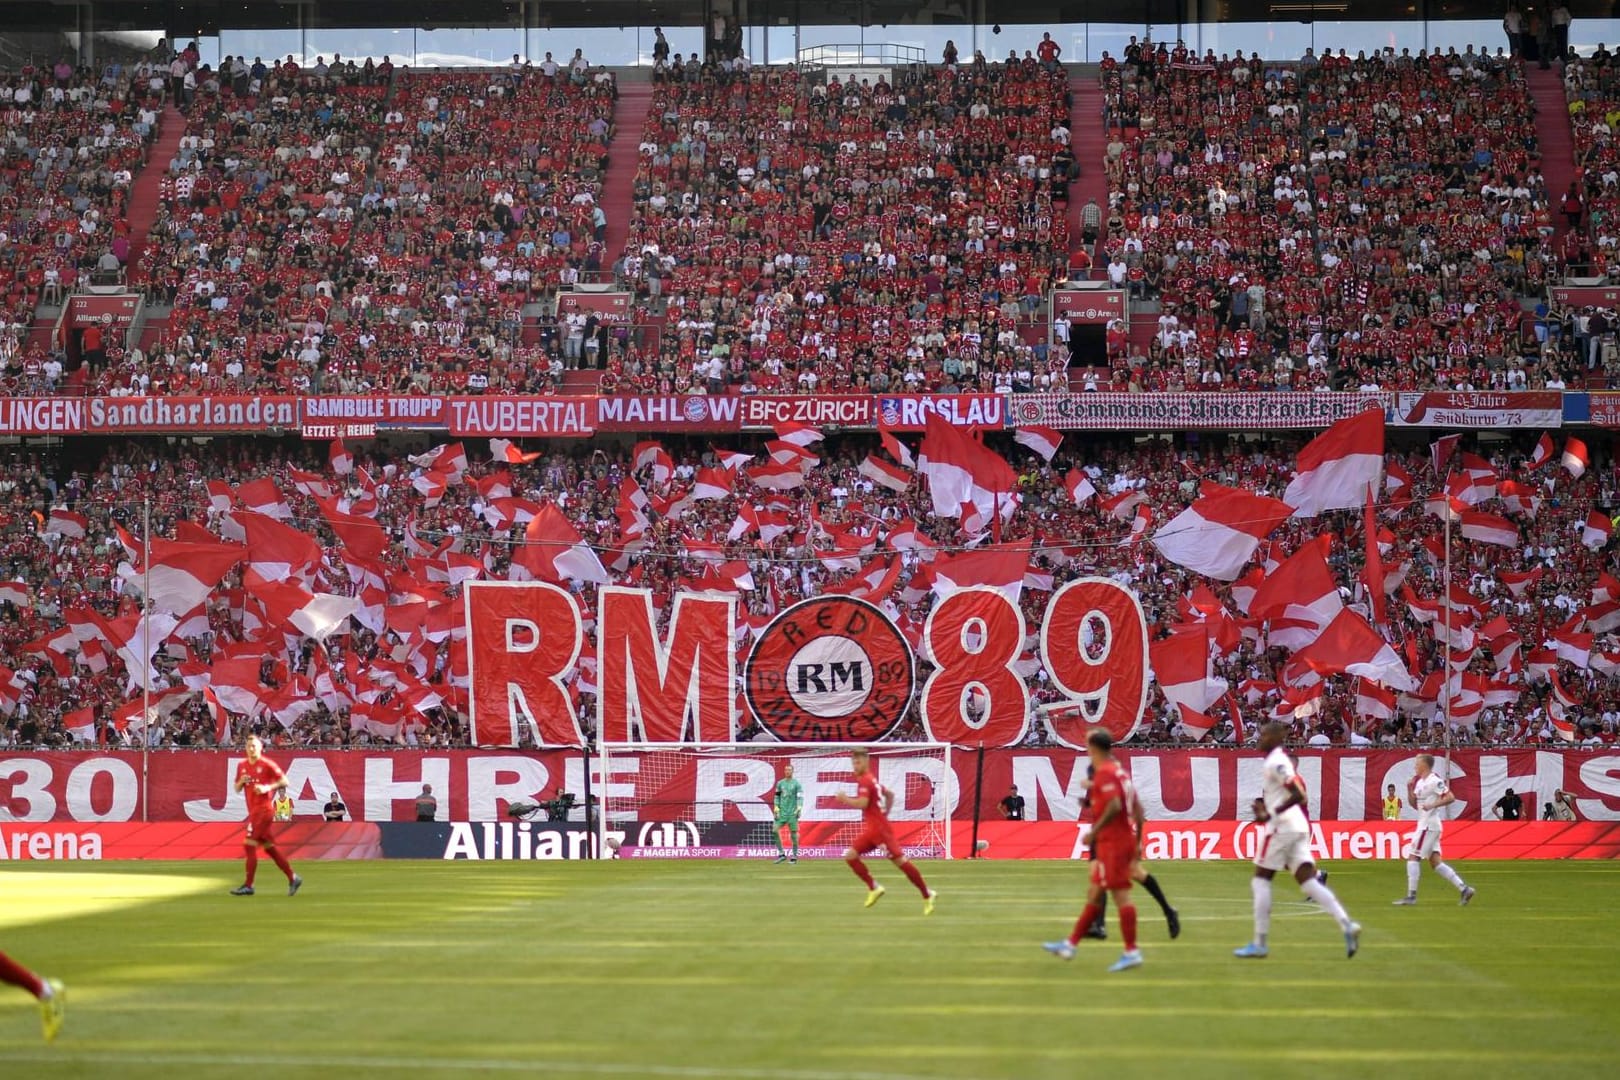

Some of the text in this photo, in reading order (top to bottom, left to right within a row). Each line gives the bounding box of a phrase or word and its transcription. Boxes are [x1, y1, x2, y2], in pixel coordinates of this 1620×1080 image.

[90, 398, 293, 427] Sandharlanden
[306, 398, 442, 417] BAMBULE TRUPP
[750, 400, 790, 421] BFC
[793, 397, 868, 421] ZÜRICH
[902, 396, 1000, 425] RÖSLAU
[1056, 399, 1181, 419] Commando
[1469, 392, 1508, 409] Jahre
[452, 401, 593, 432] TAUBERTAL
[302, 424, 375, 437] LETZTE REIHE
[464, 576, 1149, 750] RM 89
[796, 660, 865, 694] RM
[183, 755, 640, 822] JAHRE
[695, 756, 961, 822] RED
[643, 849, 721, 857] MAGENTA SPORT
